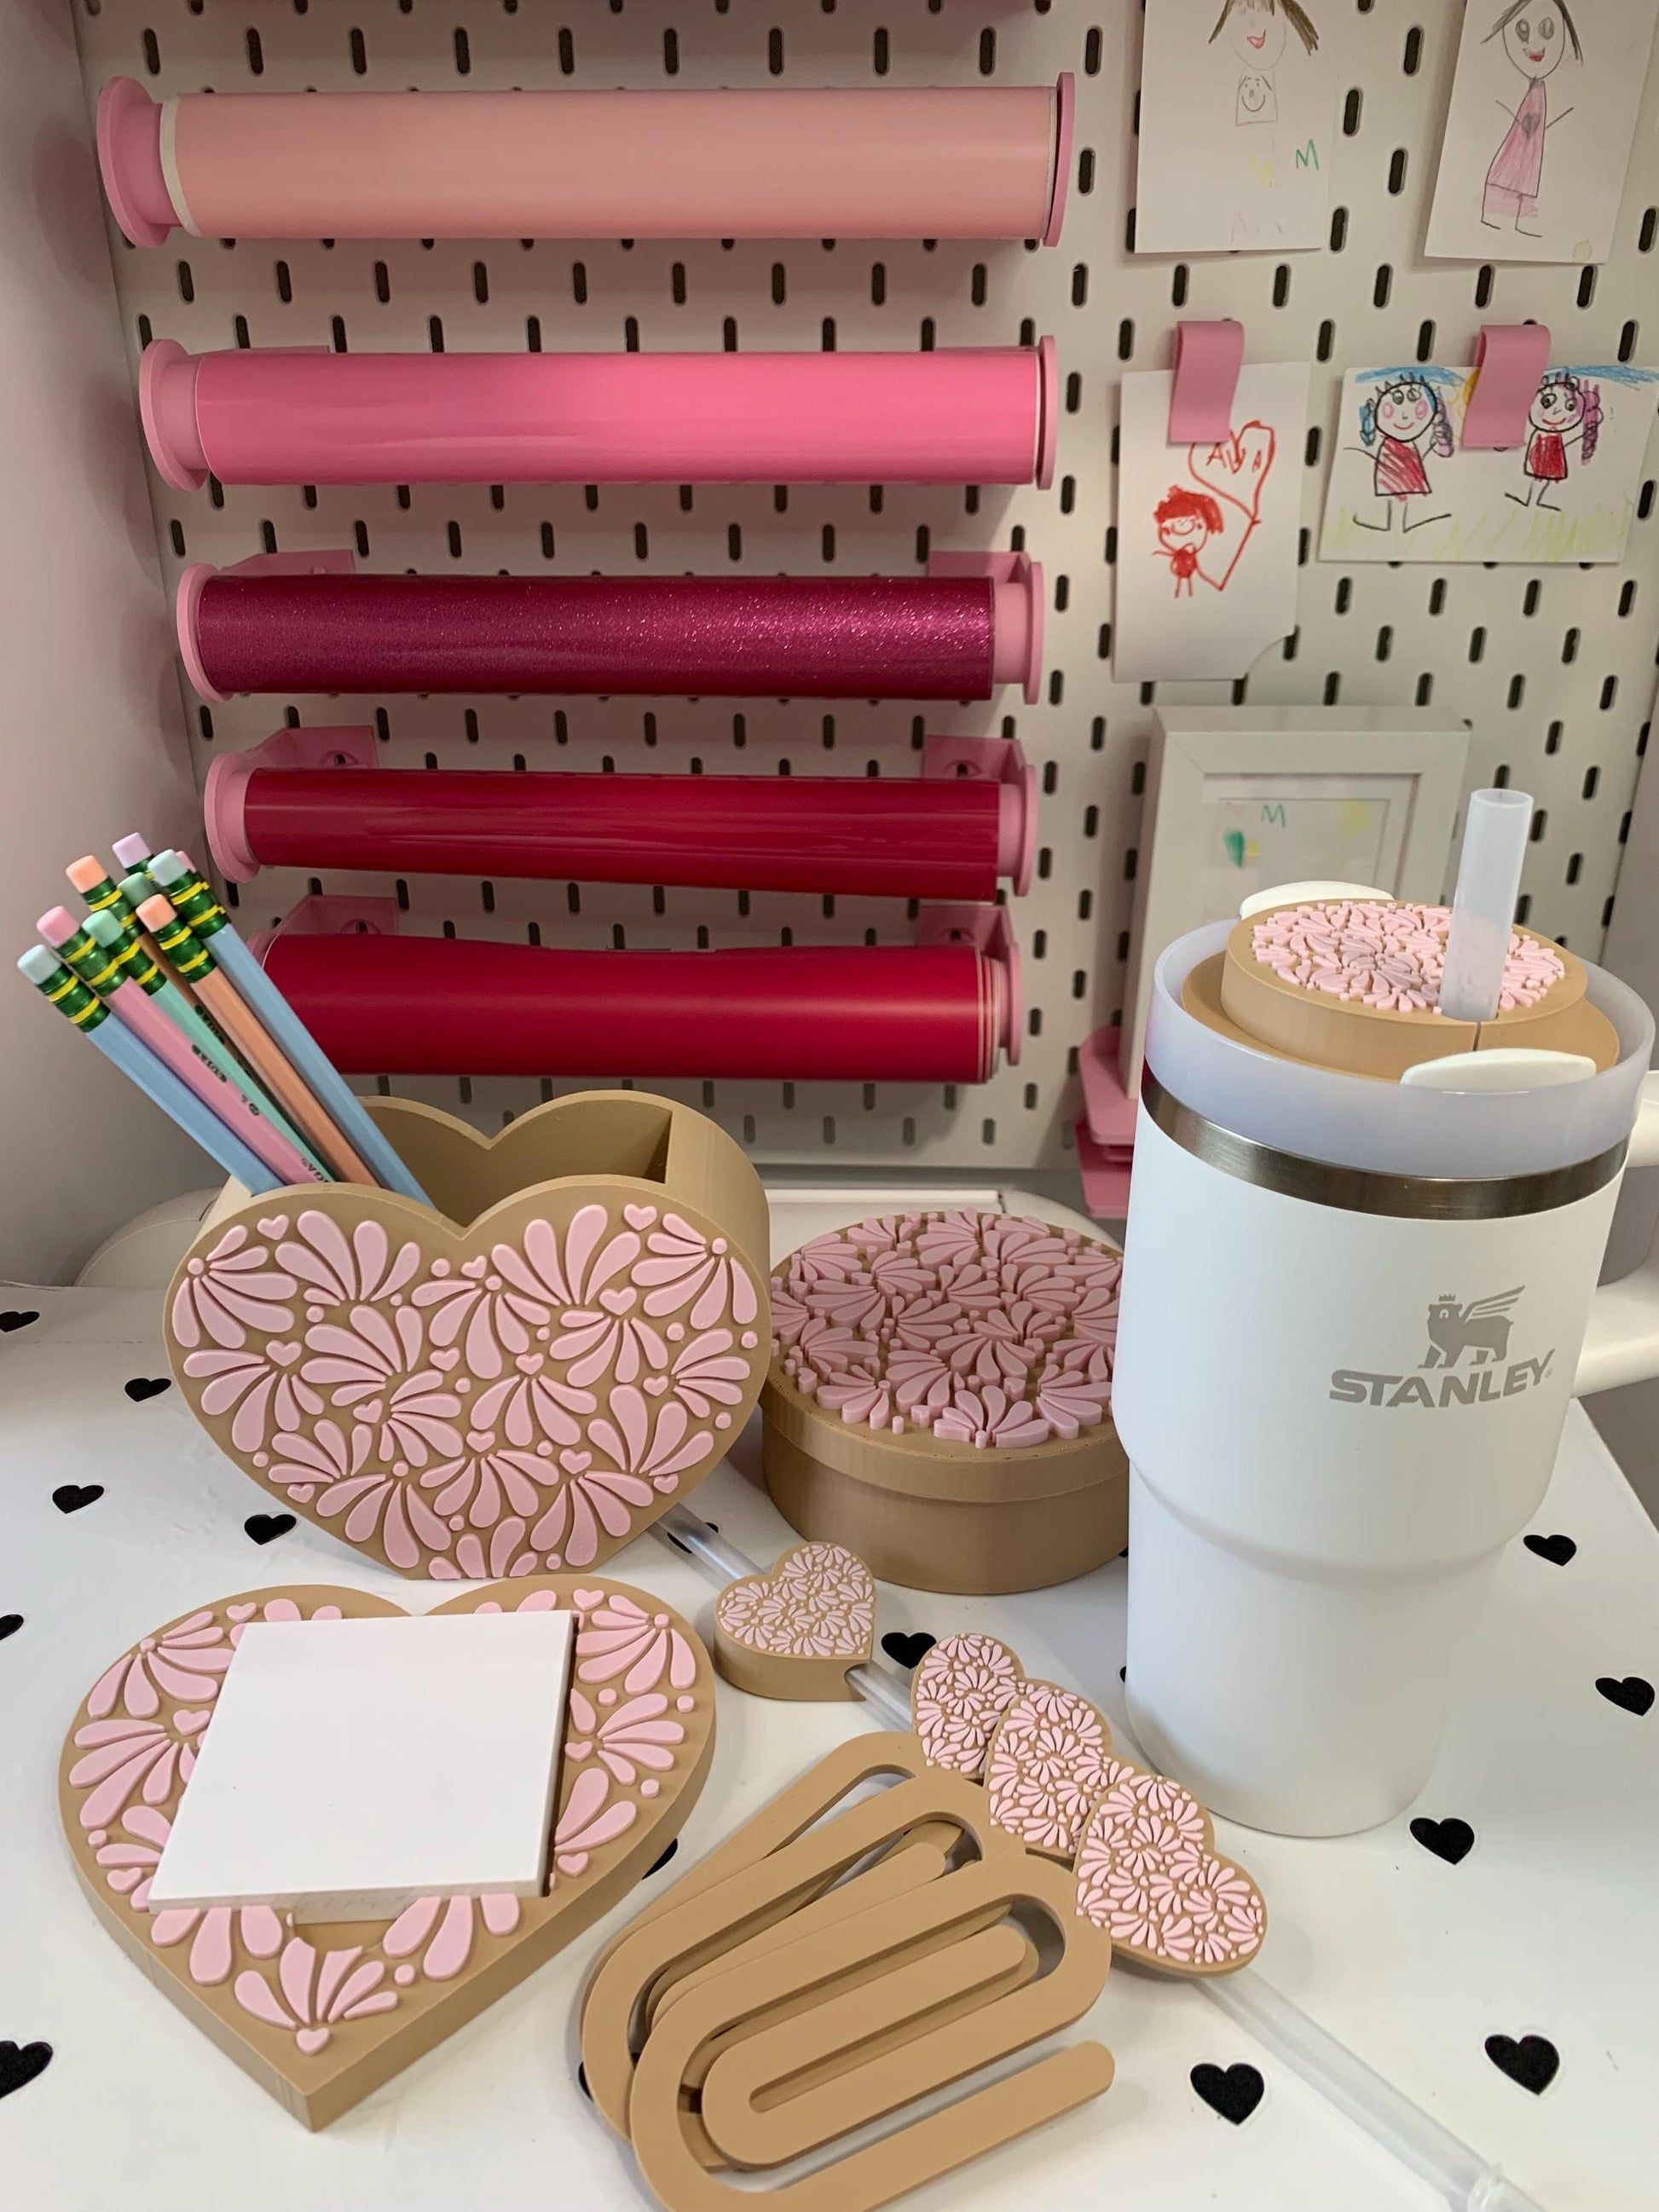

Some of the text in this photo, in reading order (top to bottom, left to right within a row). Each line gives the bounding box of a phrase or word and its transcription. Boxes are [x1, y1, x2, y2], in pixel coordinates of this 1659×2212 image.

[1295, 138, 1319, 171] M
[1260, 803, 1286, 829] M
[1328, 1348, 1556, 1408] STANLEY
